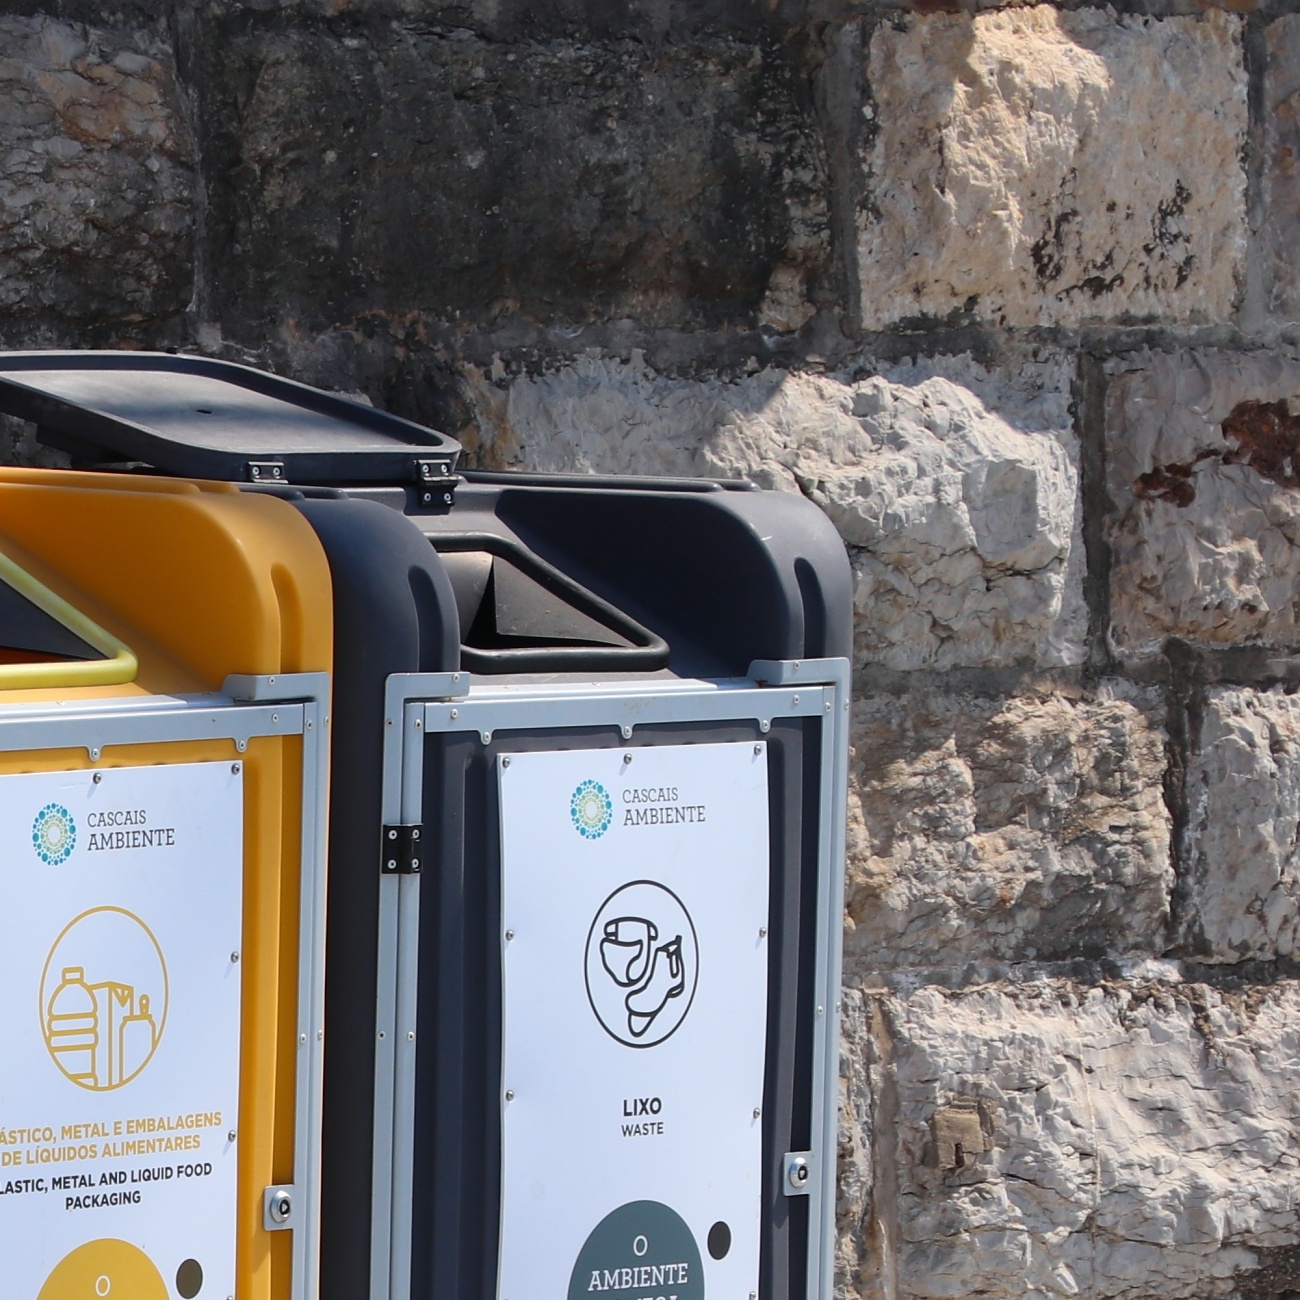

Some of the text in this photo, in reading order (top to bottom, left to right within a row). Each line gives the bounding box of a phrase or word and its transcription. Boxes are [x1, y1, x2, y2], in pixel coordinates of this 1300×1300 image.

[622, 787, 679, 804] CASCAIS
[87, 809, 147, 828] CASCAIS
[623, 805, 706, 826] AMBIENTE
[87, 828, 175, 851] AMBIENTE
[623, 1097, 662, 1117] LIXO
[61, 1122, 110, 1141] METAL
[113, 1121, 123, 1136] E
[126, 1111, 223, 1135] EMBALAGENS
[621, 1121, 664, 1137] WASTE
[1, 1134, 201, 1167] DE LÍQUIDOS ALIMENTARES
[51, 1173, 96, 1191] METAL
[99, 1170, 128, 1187] AND
[131, 1166, 174, 1184] LIQUID
[177, 1162, 213, 1179] FOOD
[65, 1190, 142, 1211] PACKAGING
[633, 1235, 648, 1257] O
[95, 1275, 111, 1297] O
[587, 1262, 688, 1292] AMBIENTE
